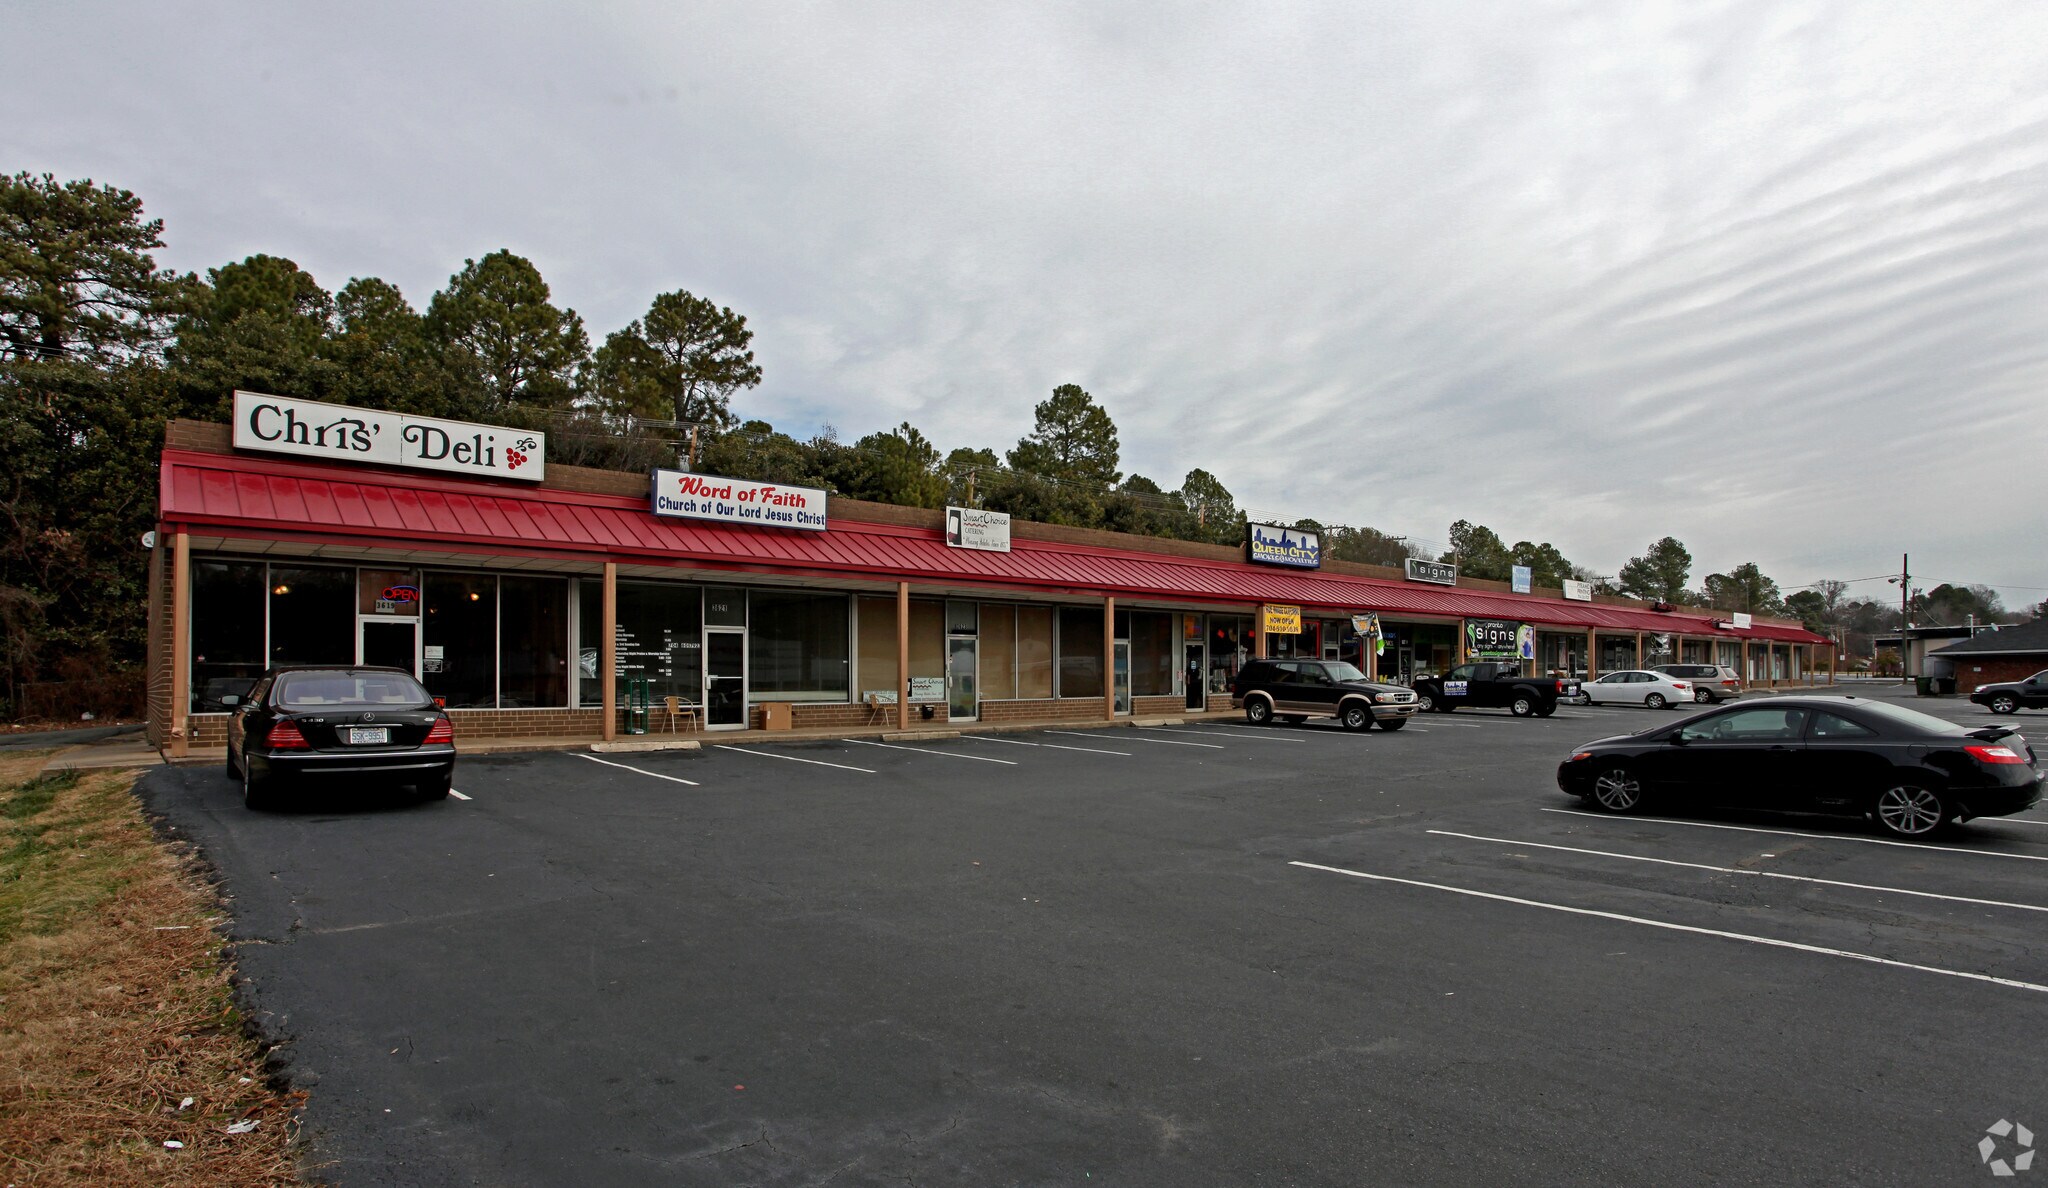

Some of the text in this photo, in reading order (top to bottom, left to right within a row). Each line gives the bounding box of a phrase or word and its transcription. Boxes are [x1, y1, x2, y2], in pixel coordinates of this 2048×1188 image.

[250, 404, 496, 467] Chris' Deli
[678, 476, 806, 508] Word of Faith
[658, 496, 825, 525] Church of Our Lord Jesus Christ
[963, 509, 1008, 525] Smart Choice
[1252, 541, 1318, 559] QUEEN CITY
[1420, 566, 1453, 578] signs
[382, 587, 419, 600] OPEN
